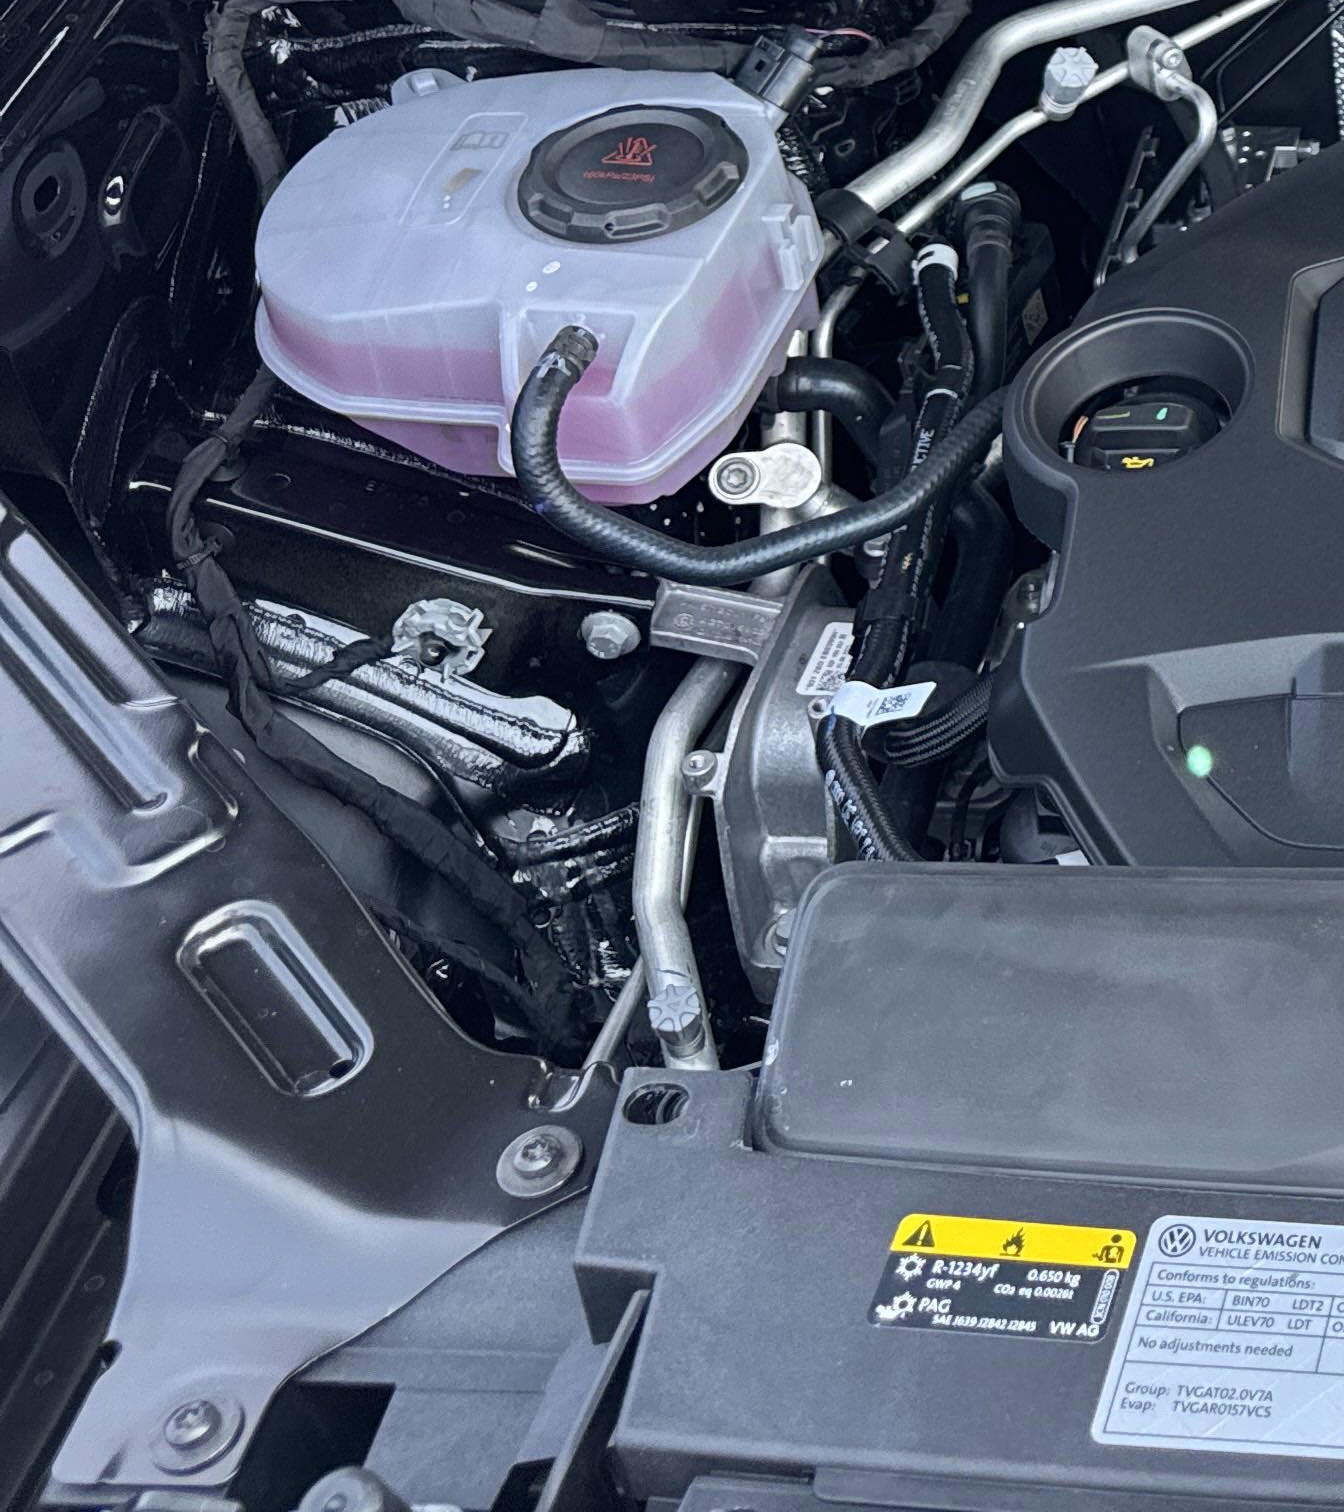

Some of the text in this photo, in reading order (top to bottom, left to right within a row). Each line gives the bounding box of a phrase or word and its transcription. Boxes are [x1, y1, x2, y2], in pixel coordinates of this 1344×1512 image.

[1203, 1228, 1323, 1249] VOLKSWAGEN
[1199, 1246, 1250, 1259] VEHICLE
[1254, 1250, 1317, 1263] EMISSION
[932, 1260, 1000, 1280] R-1234yf
[1027, 1269, 1081, 1287] 0.650 kg
[927, 1278, 961, 1290] GWP 4
[1157, 1269, 1316, 1290] Conforms to regulations:
[1019, 1286, 1032, 1298] eq
[1152, 1289, 1207, 1304] U.S. EPA:
[918, 1298, 951, 1313] PAG
[1232, 1295, 1325, 1312] BIN70 LDT2
[932, 1314, 950, 1325] SAE
[1145, 1309, 1213, 1325] California:
[1227, 1315, 1313, 1330] ULEV70 LDT
[1050, 1321, 1100, 1337] VW AG
[1138, 1337, 1294, 1357] No adjustments needed
[1124, 1382, 1170, 1397] Group:
[1120, 1398, 1157, 1412] Evap:
